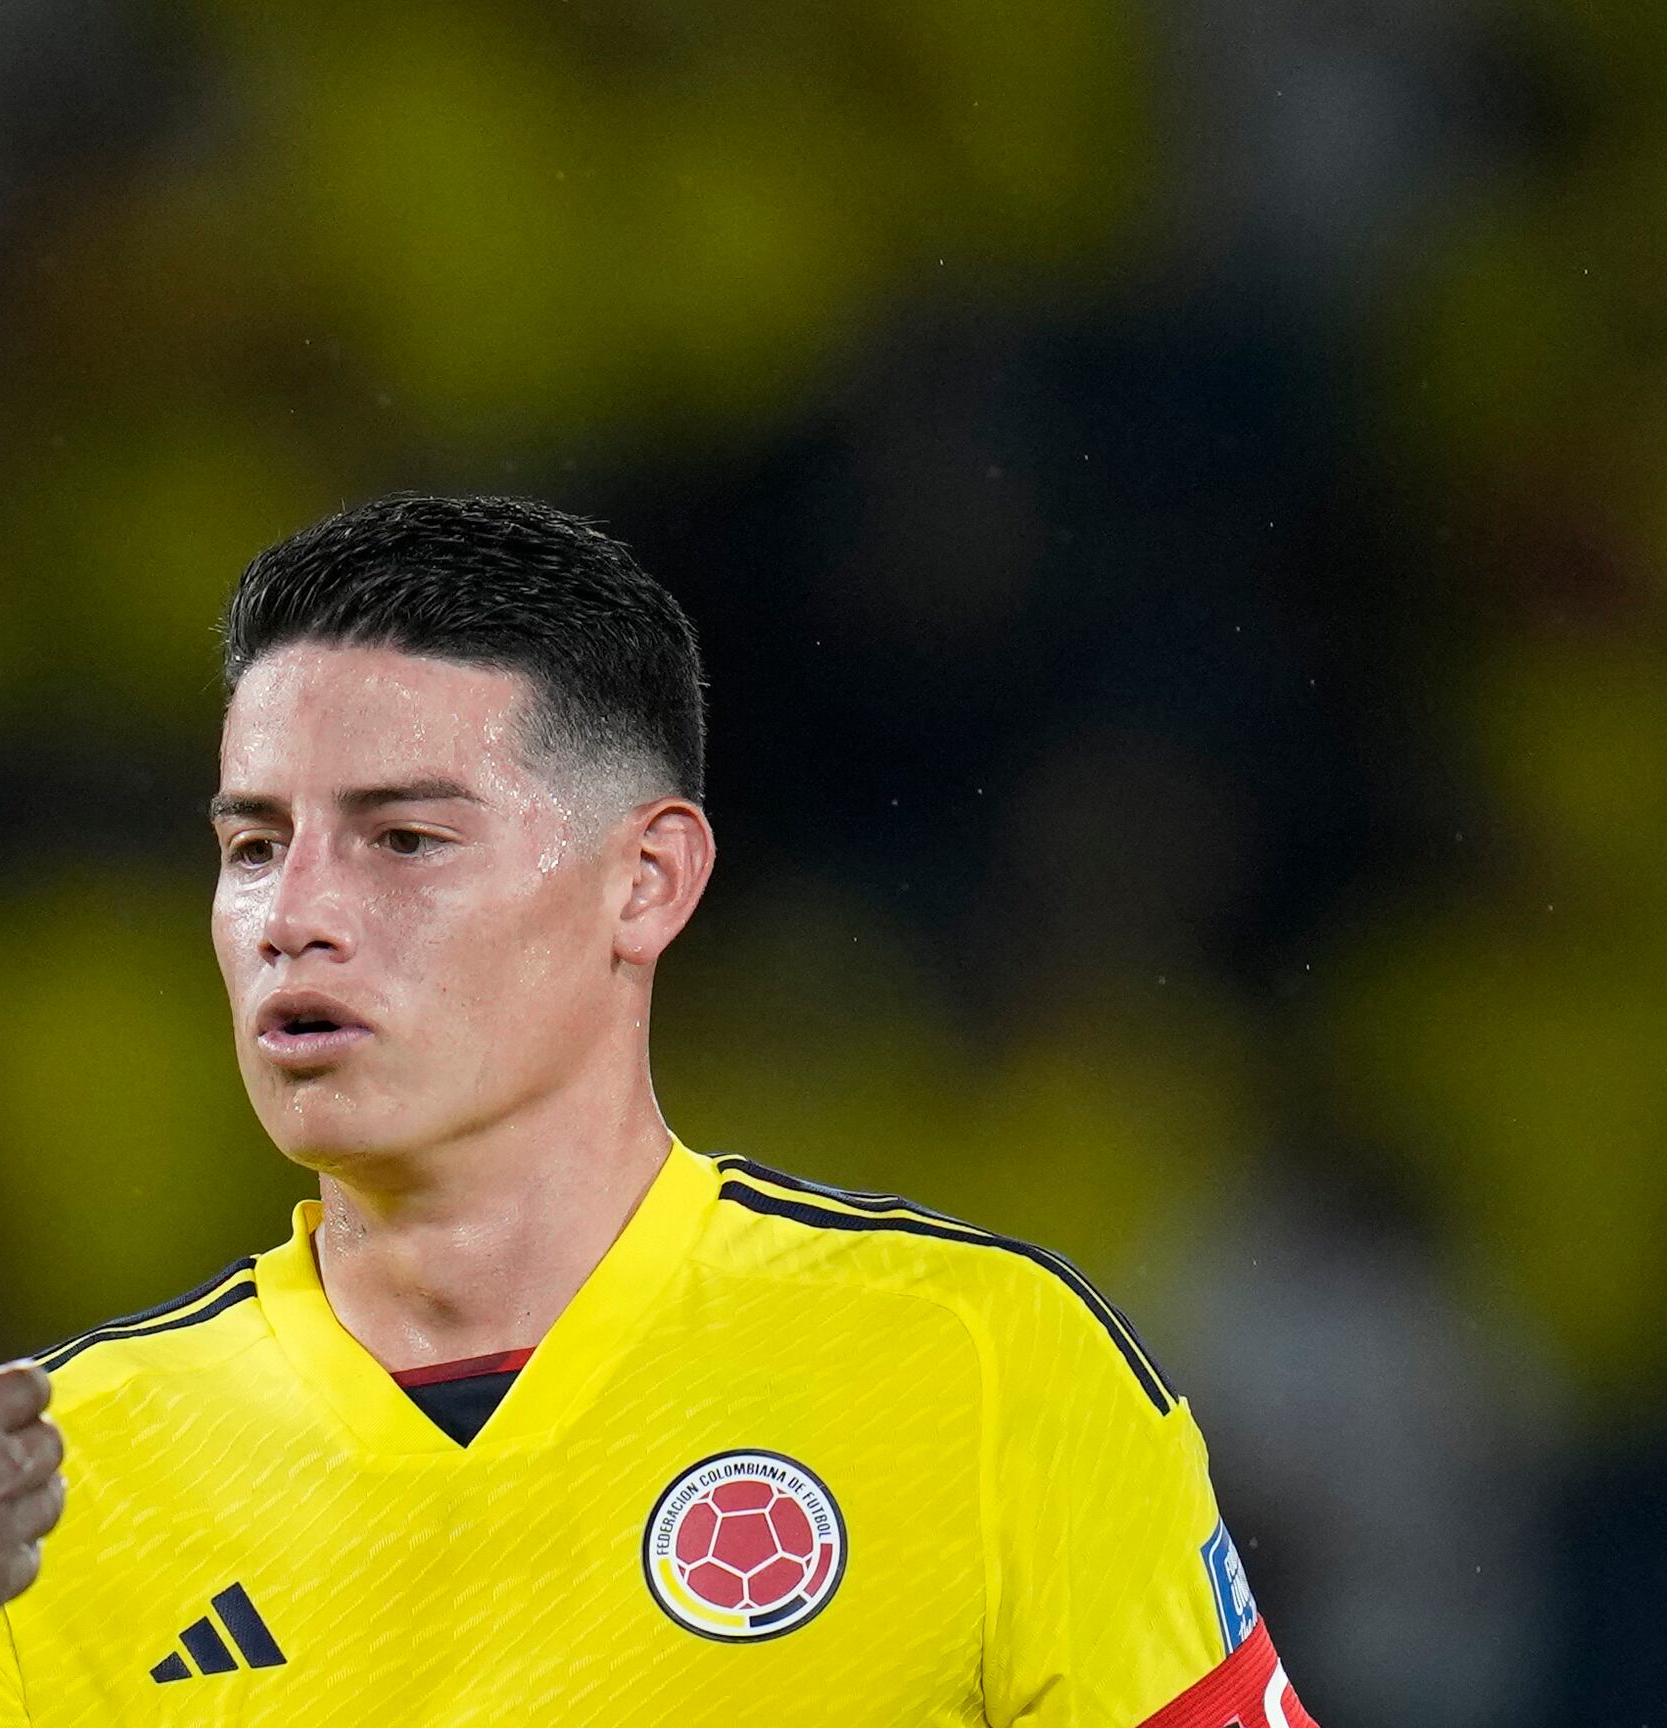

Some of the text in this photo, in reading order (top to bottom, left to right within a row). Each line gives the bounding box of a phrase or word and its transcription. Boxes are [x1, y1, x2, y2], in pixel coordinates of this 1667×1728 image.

[656, 1462, 833, 1556] FEDERACION COLOMBIANA DE FUTBOL
